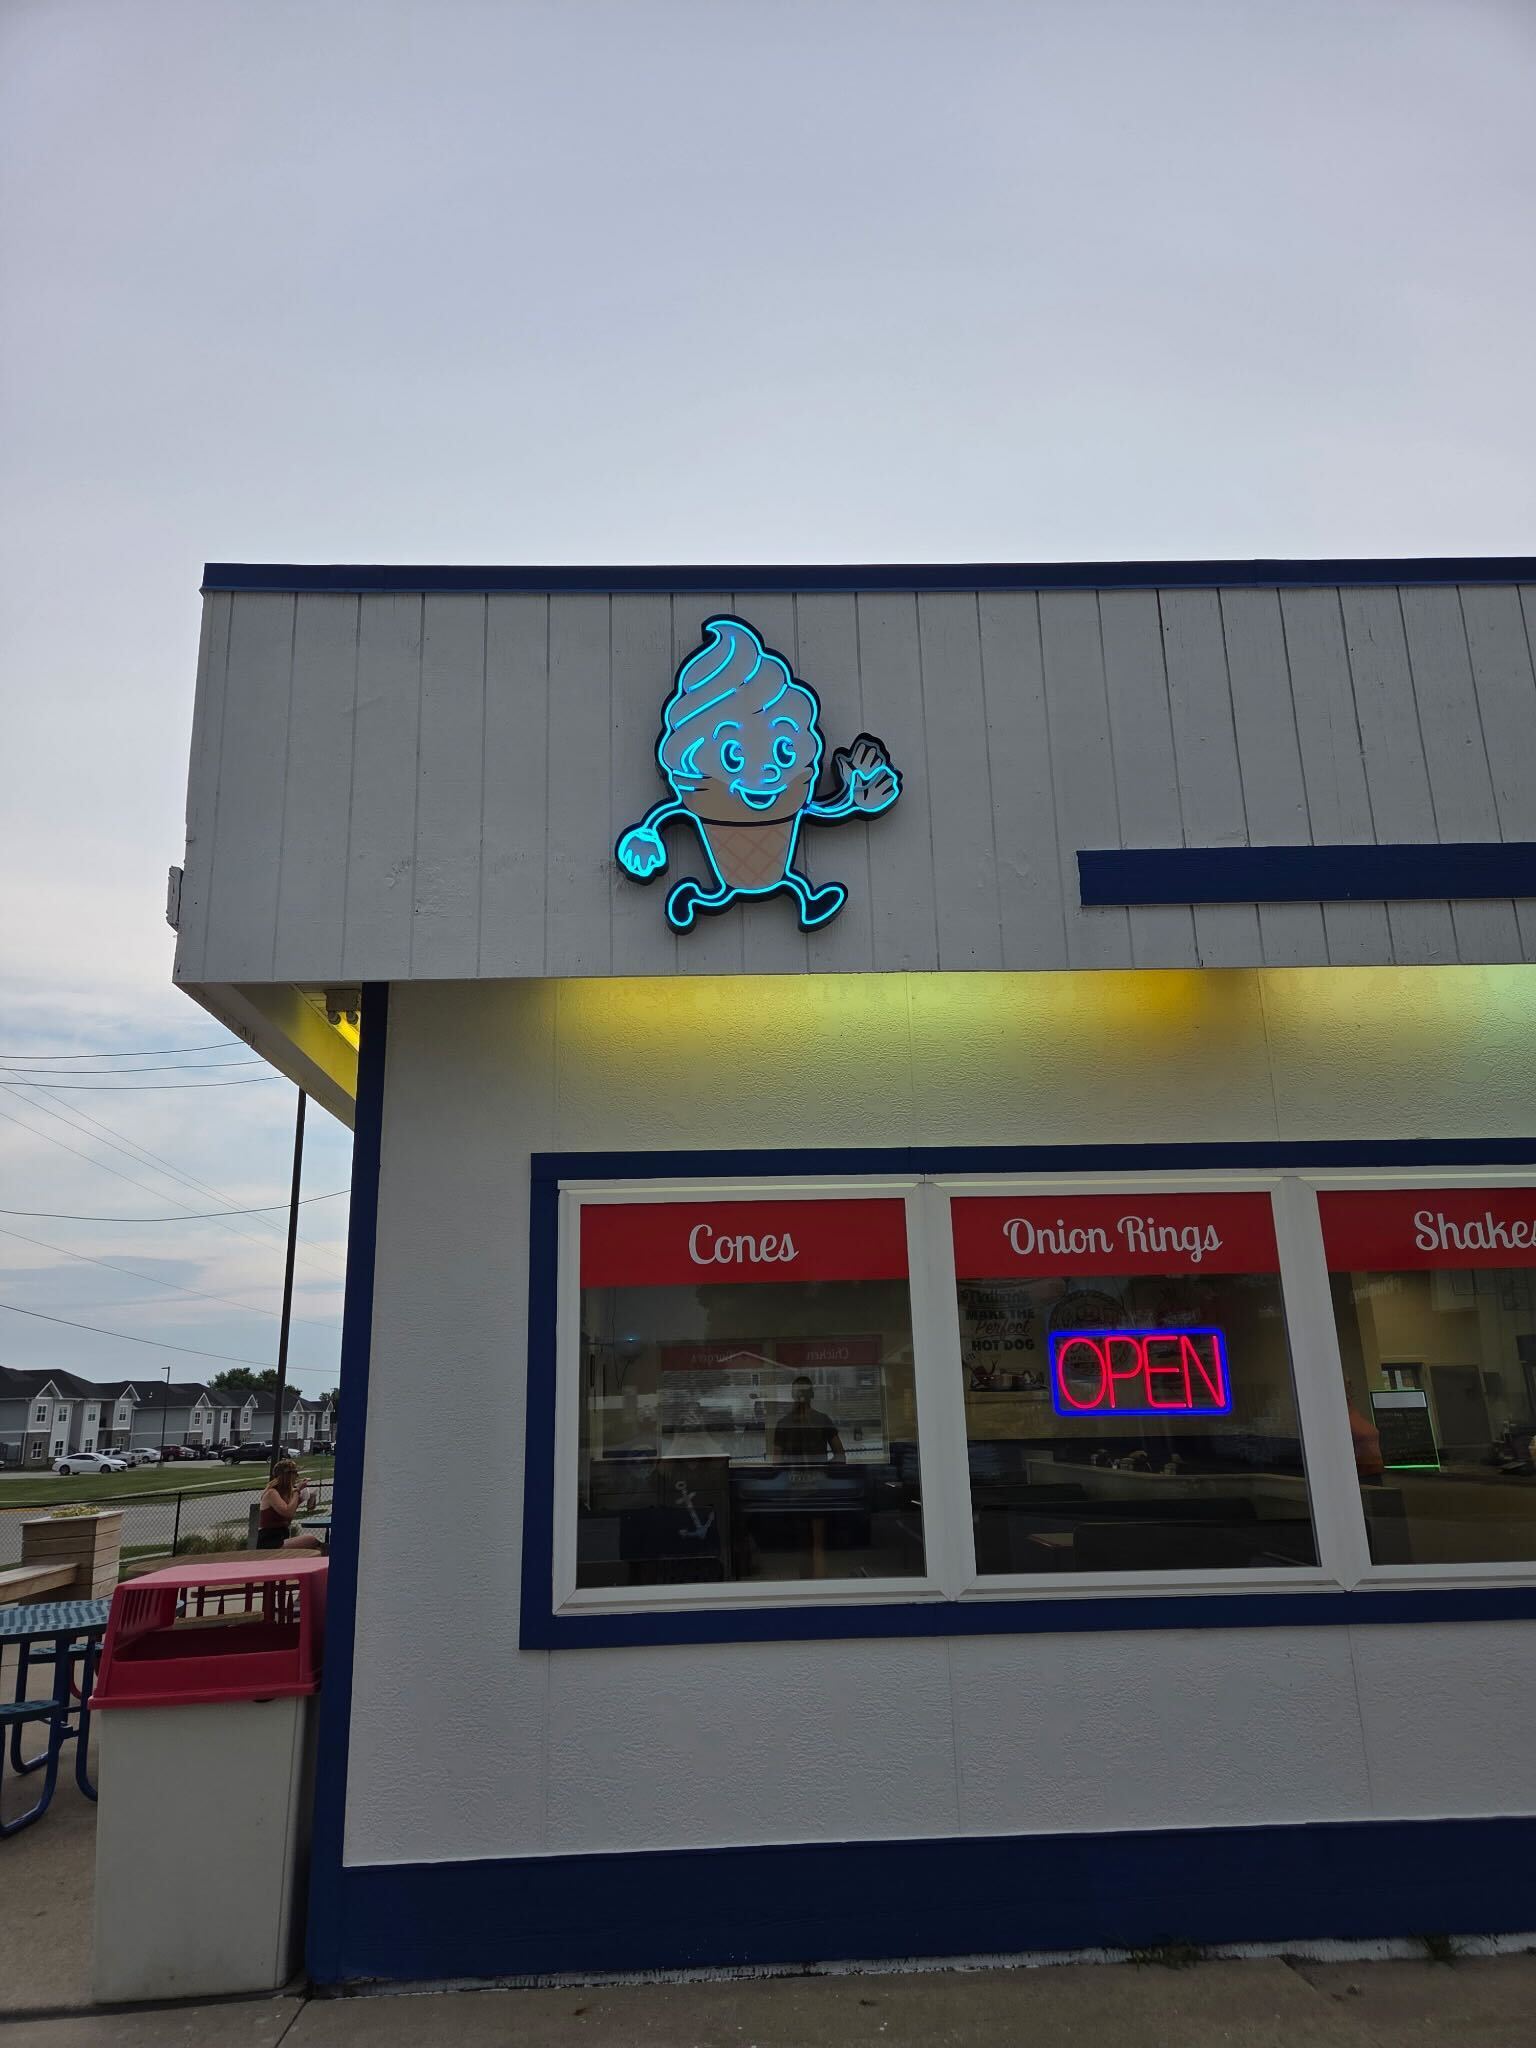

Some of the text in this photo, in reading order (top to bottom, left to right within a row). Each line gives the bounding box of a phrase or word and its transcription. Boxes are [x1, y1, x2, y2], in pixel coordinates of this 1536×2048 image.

[688, 1224, 799, 1265] Cones
[1003, 1216, 1223, 1262] Onion Rings
[971, 1339, 1035, 1352] HOT DOG
[1057, 1335, 1226, 1409] OPEN
